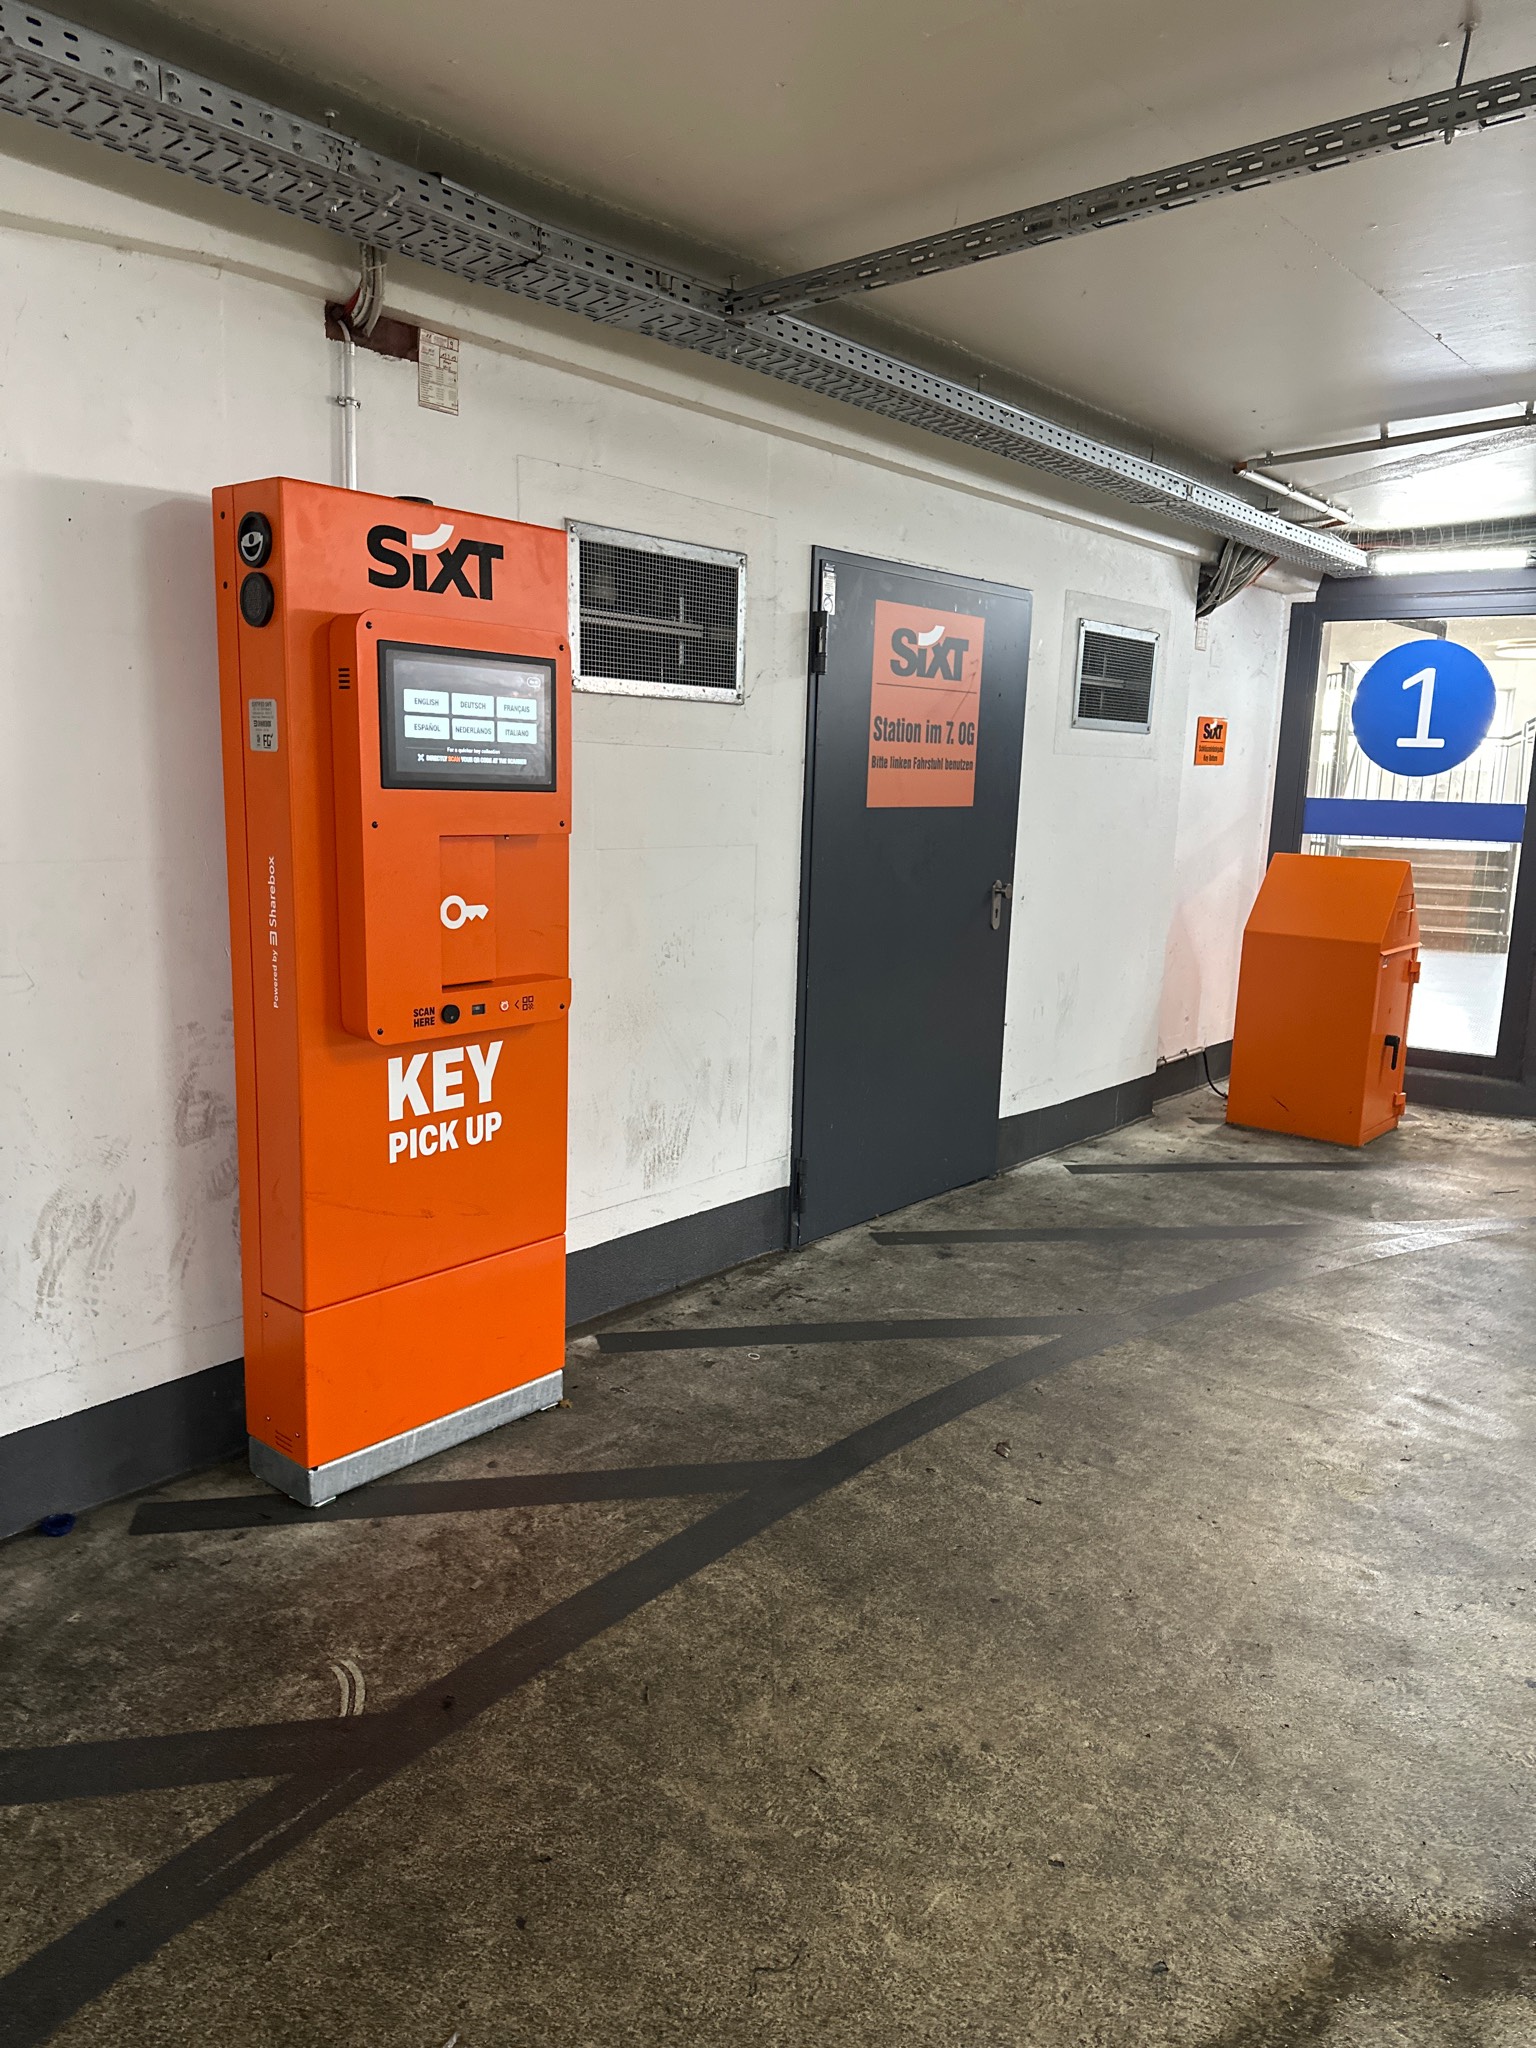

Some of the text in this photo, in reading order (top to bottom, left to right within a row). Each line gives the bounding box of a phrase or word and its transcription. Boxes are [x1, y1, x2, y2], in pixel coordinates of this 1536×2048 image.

[414, 697, 440, 706] ENGLISH
[460, 701, 487, 710] DEUTSCH
[504, 704, 530, 714] FRANÇAIS
[1397, 667, 1445, 749] 1
[414, 723, 441, 732] ESPAÑOL
[455, 726, 492, 735] NEDERLANDS
[505, 729, 529, 737] ITALIANO
[873, 716, 975, 746] Station im 7. OG
[871, 755, 973, 771] Bitte linken Fahrstuhl benutzen
[267, 856, 277, 928] Sharebox
[272, 949, 278, 962] by
[413, 1006, 435, 1018] SCAN
[413, 1016, 435, 1028] HERE
[388, 1040, 503, 1122] KEY
[389, 1111, 503, 1164] PICK UP
